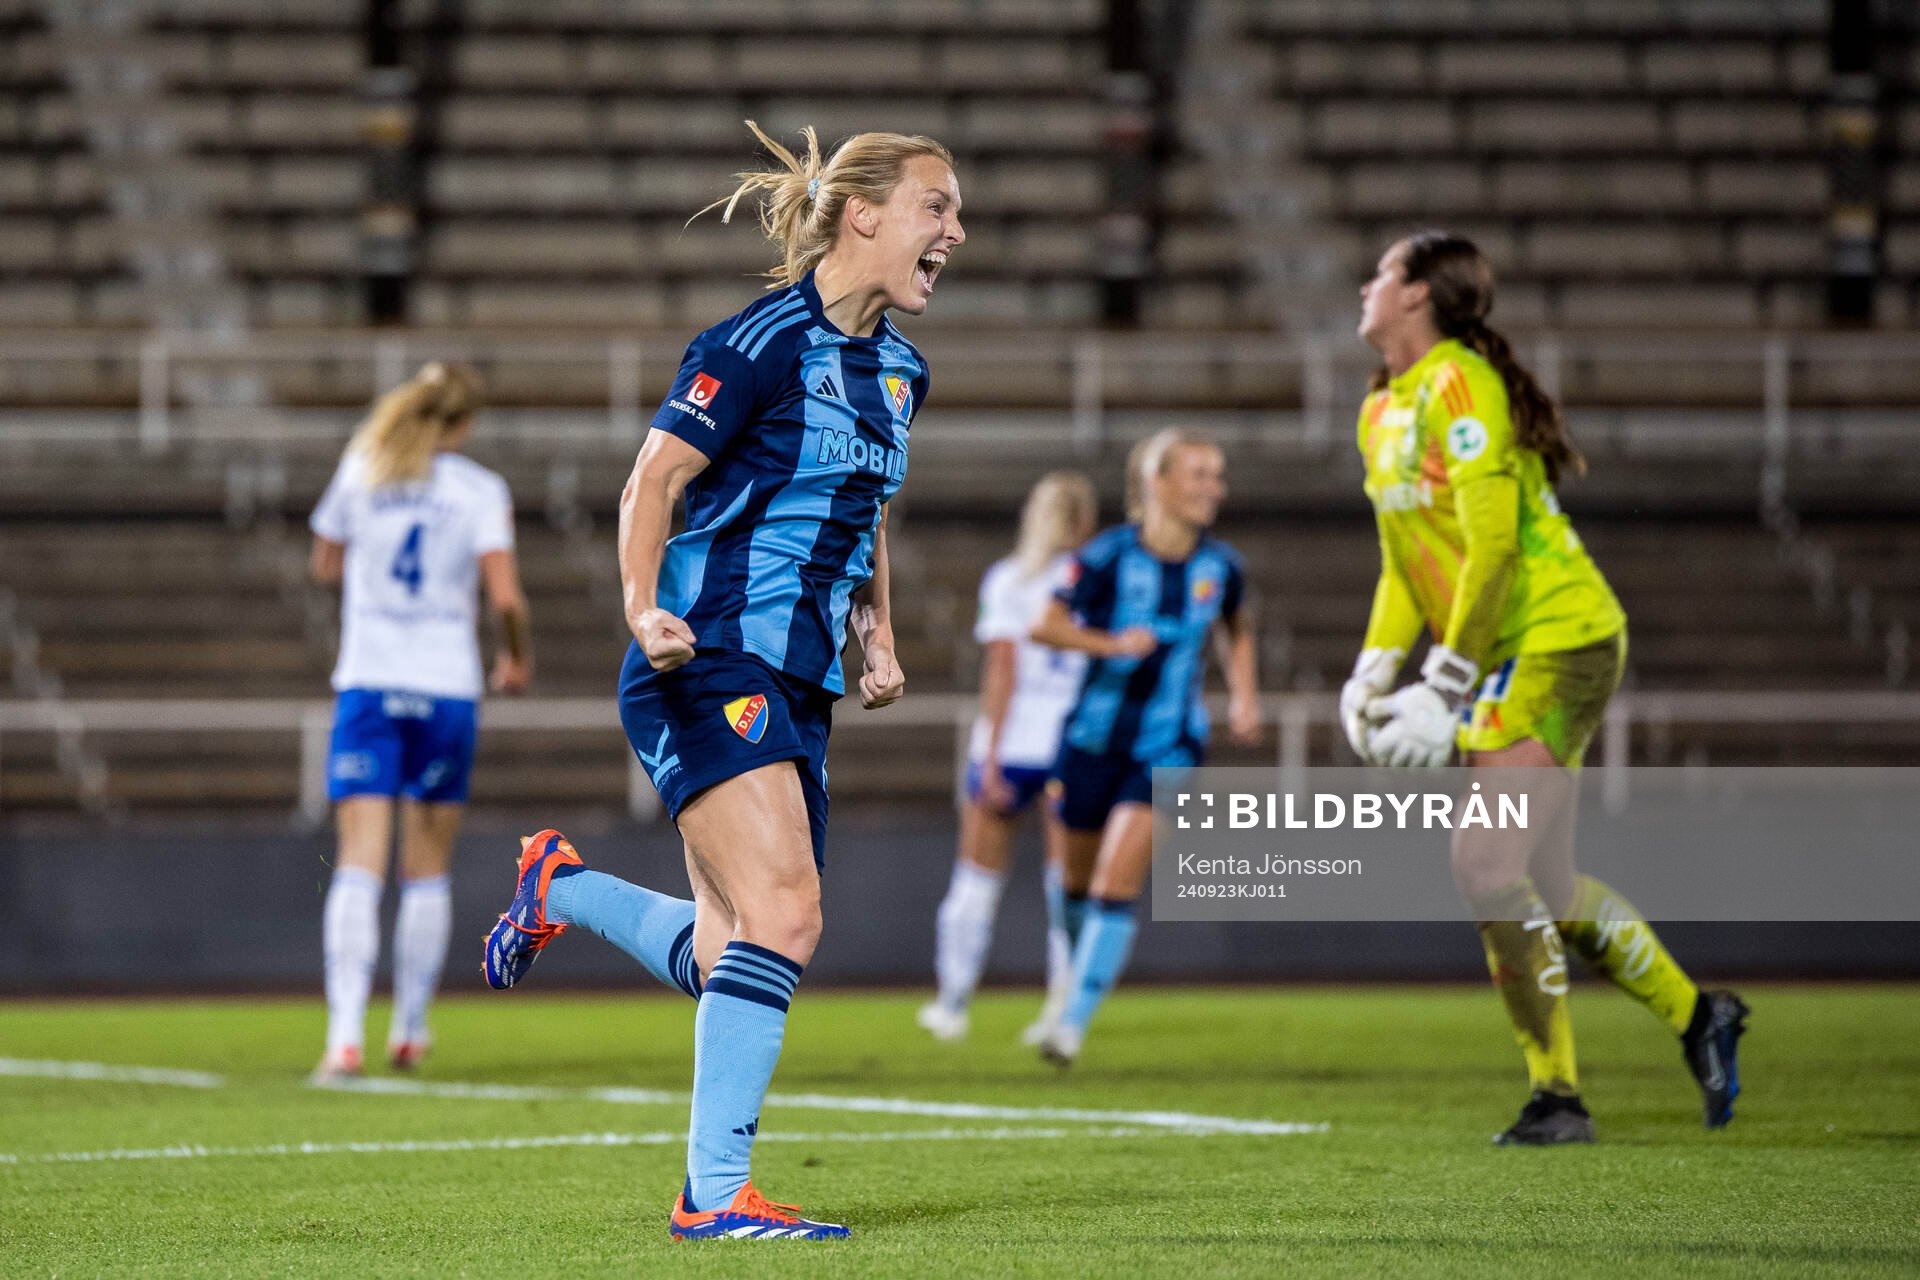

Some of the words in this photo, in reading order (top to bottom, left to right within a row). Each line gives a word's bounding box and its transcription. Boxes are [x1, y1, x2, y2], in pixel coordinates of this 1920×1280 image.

[668, 399, 697, 417] SVENSKA
[696, 411, 717, 431] SPEL
[391, 523, 424, 598] 4
